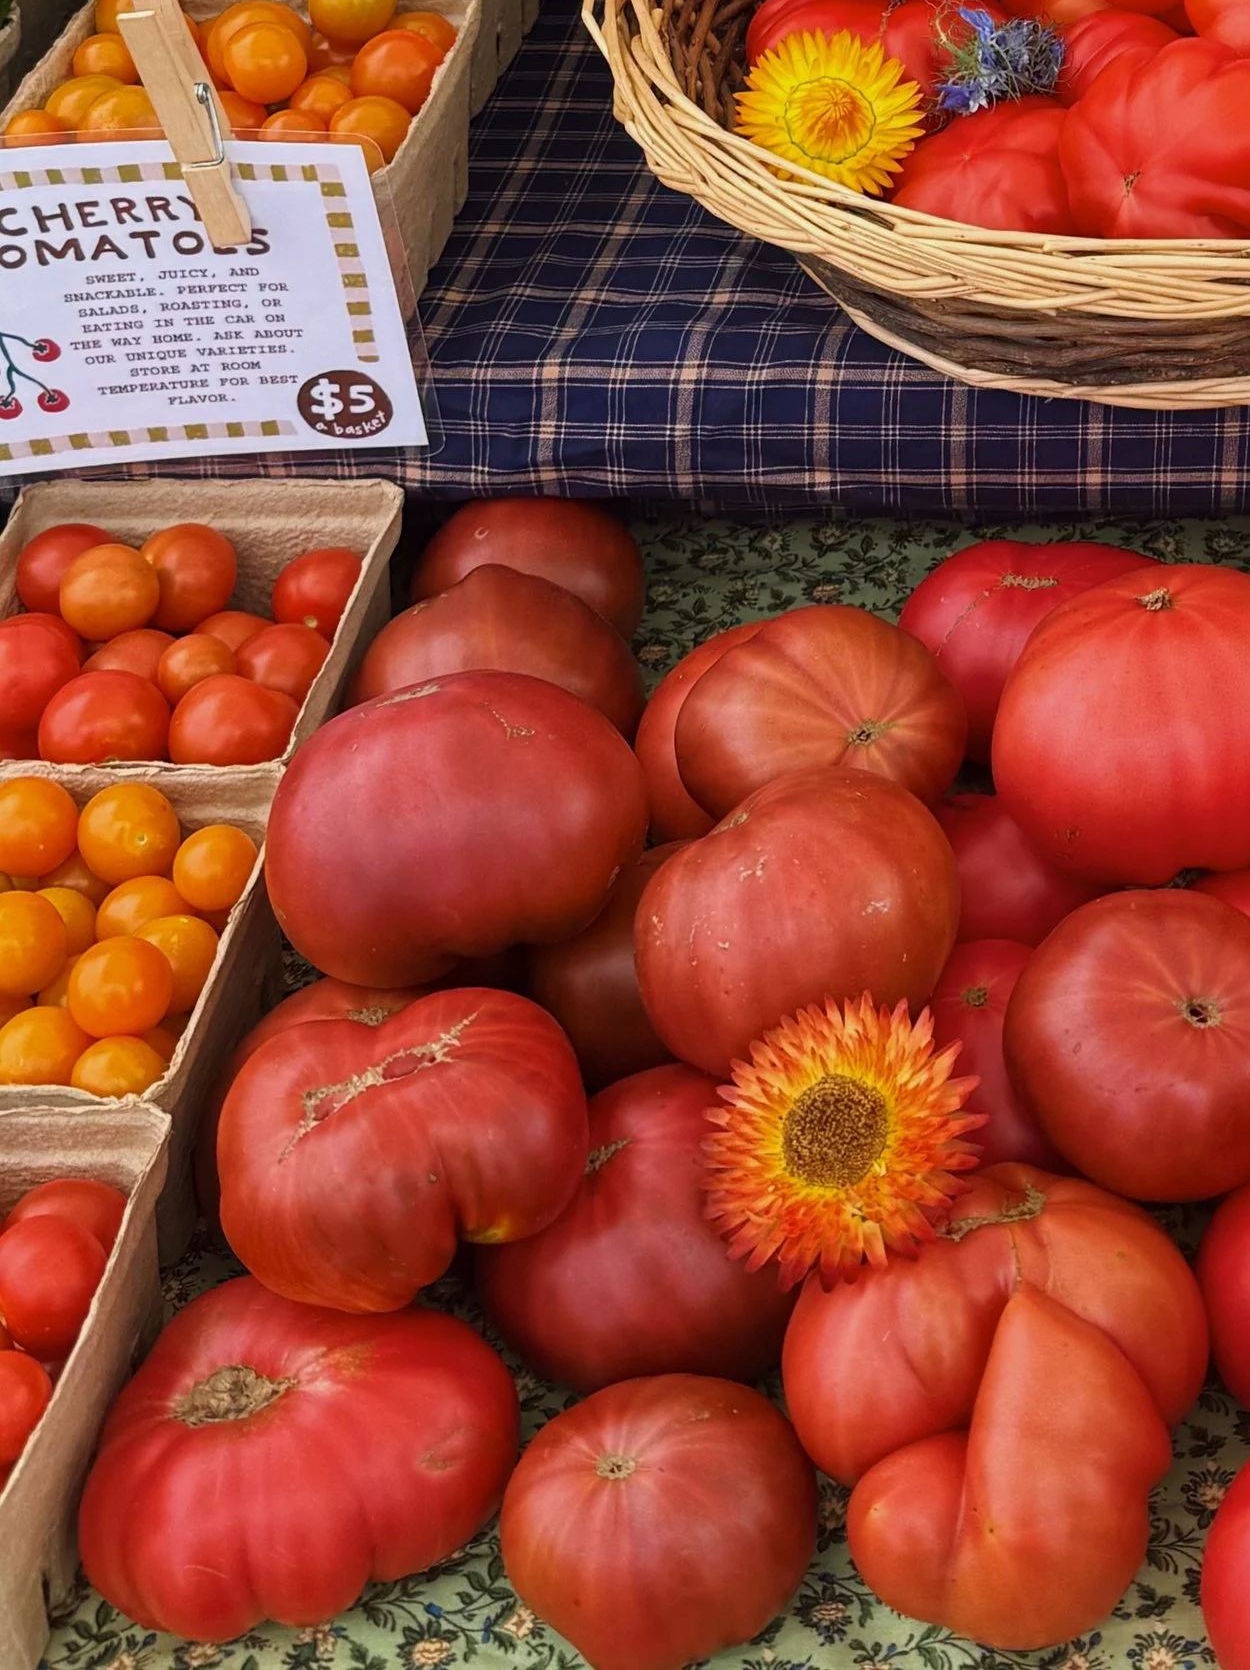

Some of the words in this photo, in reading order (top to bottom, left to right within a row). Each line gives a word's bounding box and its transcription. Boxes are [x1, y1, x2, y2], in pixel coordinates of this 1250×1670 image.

[0, 228, 270, 269] OMATOS
[85, 272, 144, 285] SWEET,
[158, 269, 216, 280] JUICY,
[229, 267, 260, 277] AND
[64, 287, 164, 303] SNACKABLE.
[176, 283, 247, 295] PERFECT
[258, 282, 289, 292] FOR
[78, 304, 147, 318] SALADS,
[159, 299, 248, 312] ROASTING,
[261, 298, 282, 307] OR
[82, 320, 144, 333] EATING
[154, 318, 174, 328] IN
[183, 316, 215, 326] THE
[225, 315, 255, 324] CAR
[265, 314, 285, 323] ON
[69, 340, 102, 350] THE
[111, 336, 141, 347] WAY
[152, 333, 201, 344] HOME.
[213, 331, 244, 340] ASK
[254, 329, 303, 339] ABOUT
[85, 354, 116, 365] OUR
[125, 349, 187, 362] UNIQUE
[196, 344, 294, 356] VARIETIES.
[130, 365, 181, 377] STORE
[190, 363, 210, 373] AT
[221, 361, 261, 371] ROOM
[97, 379, 209, 395] TEMPERATURE
[219, 377, 250, 387] FOR
[258, 375, 298, 385] BEST
[168, 393, 236, 405] FLAVOR.
[310, 378, 375, 421] $5
[316, 422, 328, 430] a
[333, 410, 386, 435] basket
